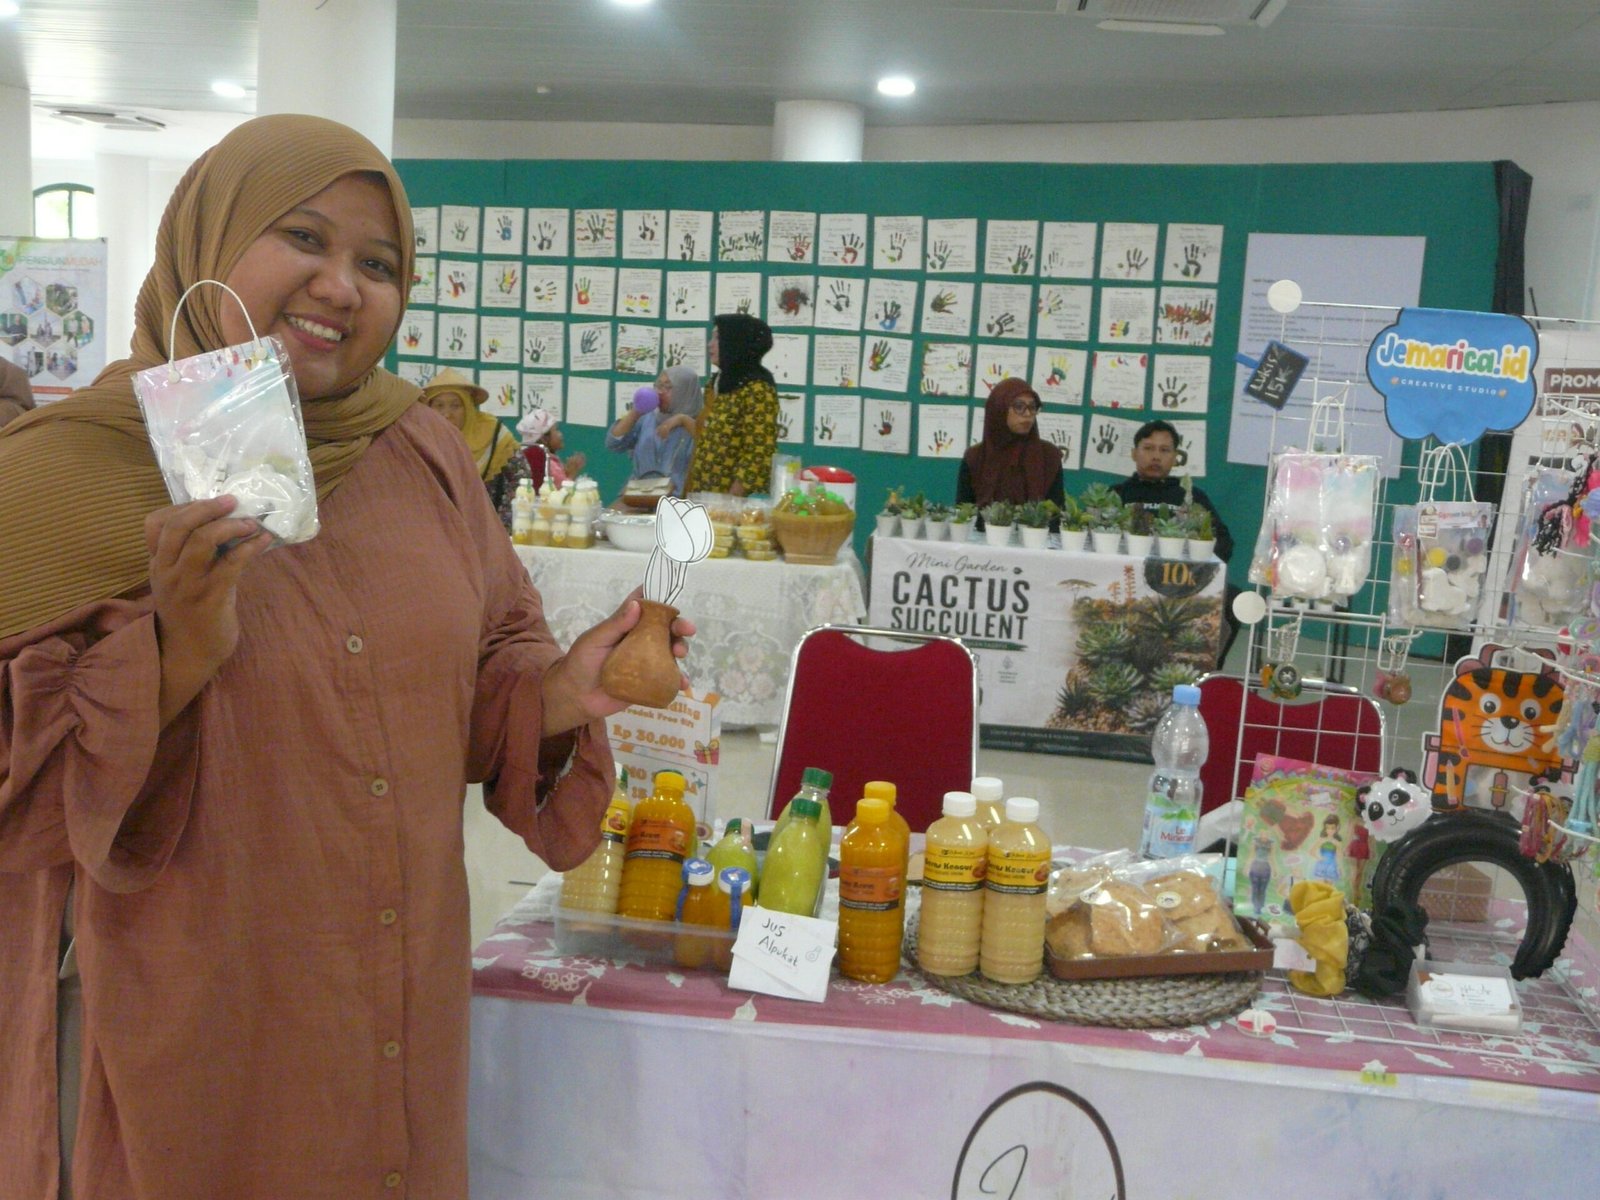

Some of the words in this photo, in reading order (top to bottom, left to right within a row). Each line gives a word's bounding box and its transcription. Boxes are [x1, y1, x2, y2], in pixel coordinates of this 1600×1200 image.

[1377, 334, 1530, 382] Jemarica.id
[1401, 378, 1453, 390] CREATIVE
[1458, 385, 1497, 395] STUDIO
[906, 552, 952, 568] Mini
[954, 555, 1008, 574] Garden
[892, 571, 1030, 614] CACTUS
[891, 606, 1029, 640] SUCCULENT
